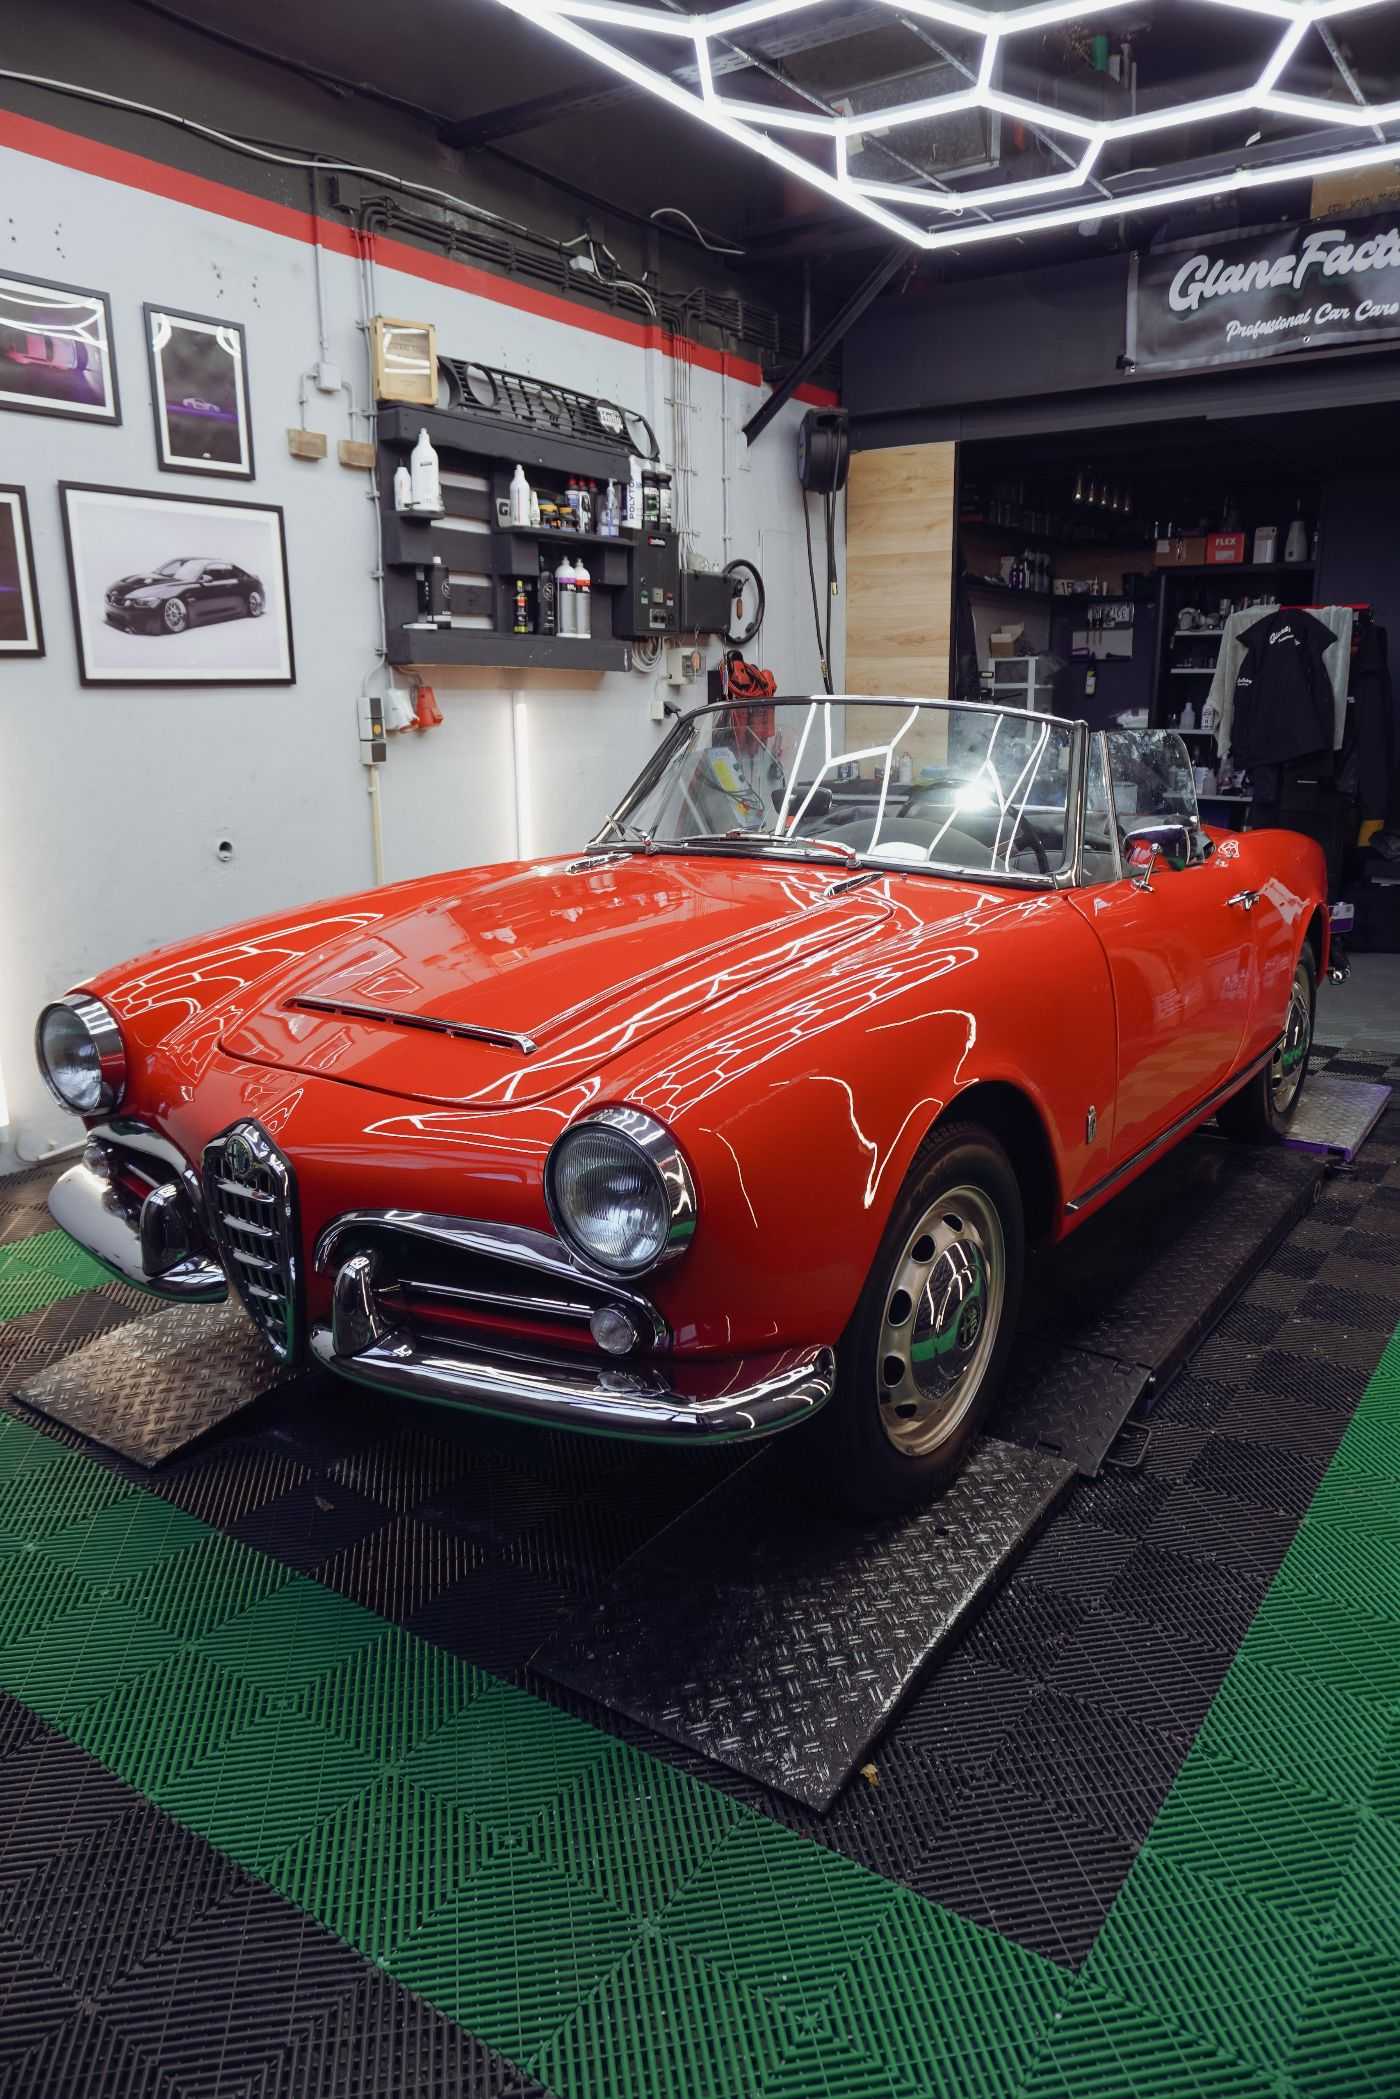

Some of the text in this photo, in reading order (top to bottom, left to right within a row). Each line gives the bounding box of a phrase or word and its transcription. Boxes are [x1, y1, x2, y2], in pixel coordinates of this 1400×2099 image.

[1226, 300, 1399, 342] Professional Car Care
[1215, 537, 1237, 546] FLEX
